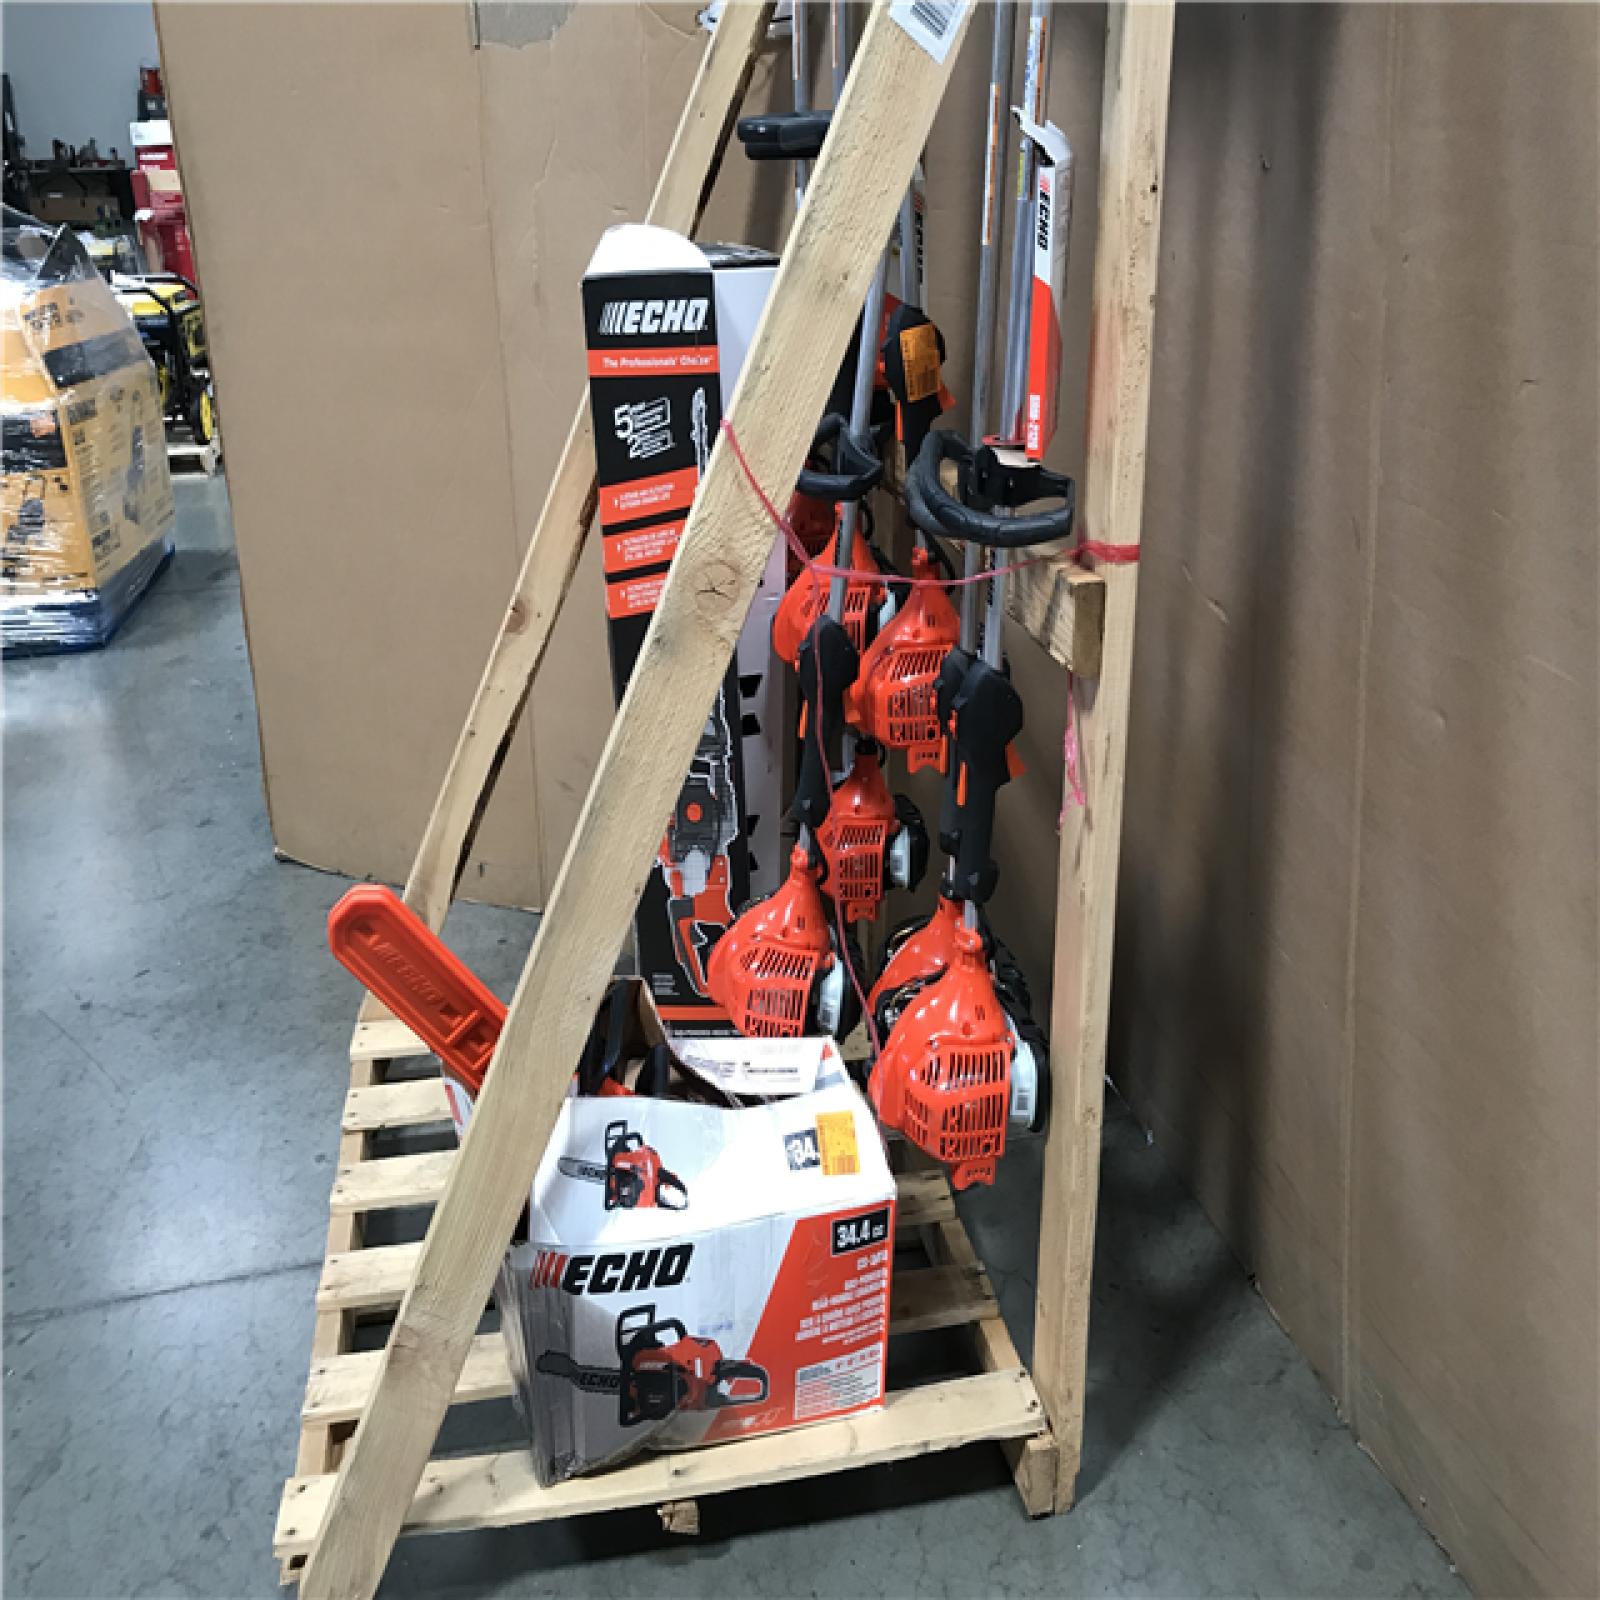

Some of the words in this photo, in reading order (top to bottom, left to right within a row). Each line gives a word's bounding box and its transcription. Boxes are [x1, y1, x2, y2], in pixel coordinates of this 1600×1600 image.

[1037, 189, 1050, 251] ECHO
[622, 298, 708, 334] ECHO
[614, 403, 633, 438] 5
[836, 1219, 870, 1249] 34.4
[561, 1243, 695, 1296] ECHO
